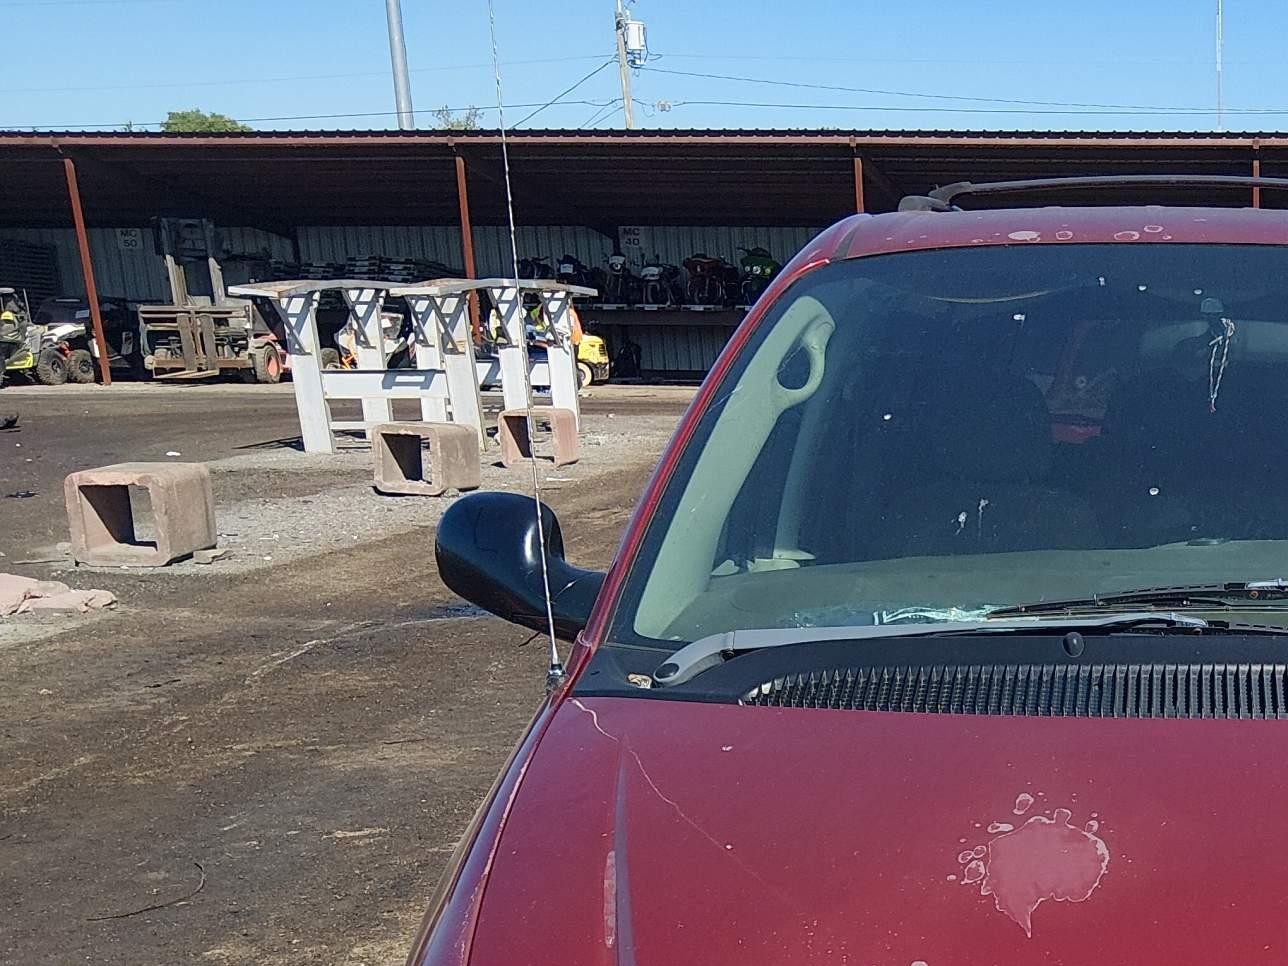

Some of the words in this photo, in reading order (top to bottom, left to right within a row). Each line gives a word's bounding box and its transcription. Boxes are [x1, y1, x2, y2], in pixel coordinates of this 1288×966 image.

[120, 230, 137, 238] MC
[623, 227, 640, 236] MC
[123, 239, 138, 248] 50
[624, 238, 640, 246] 40
